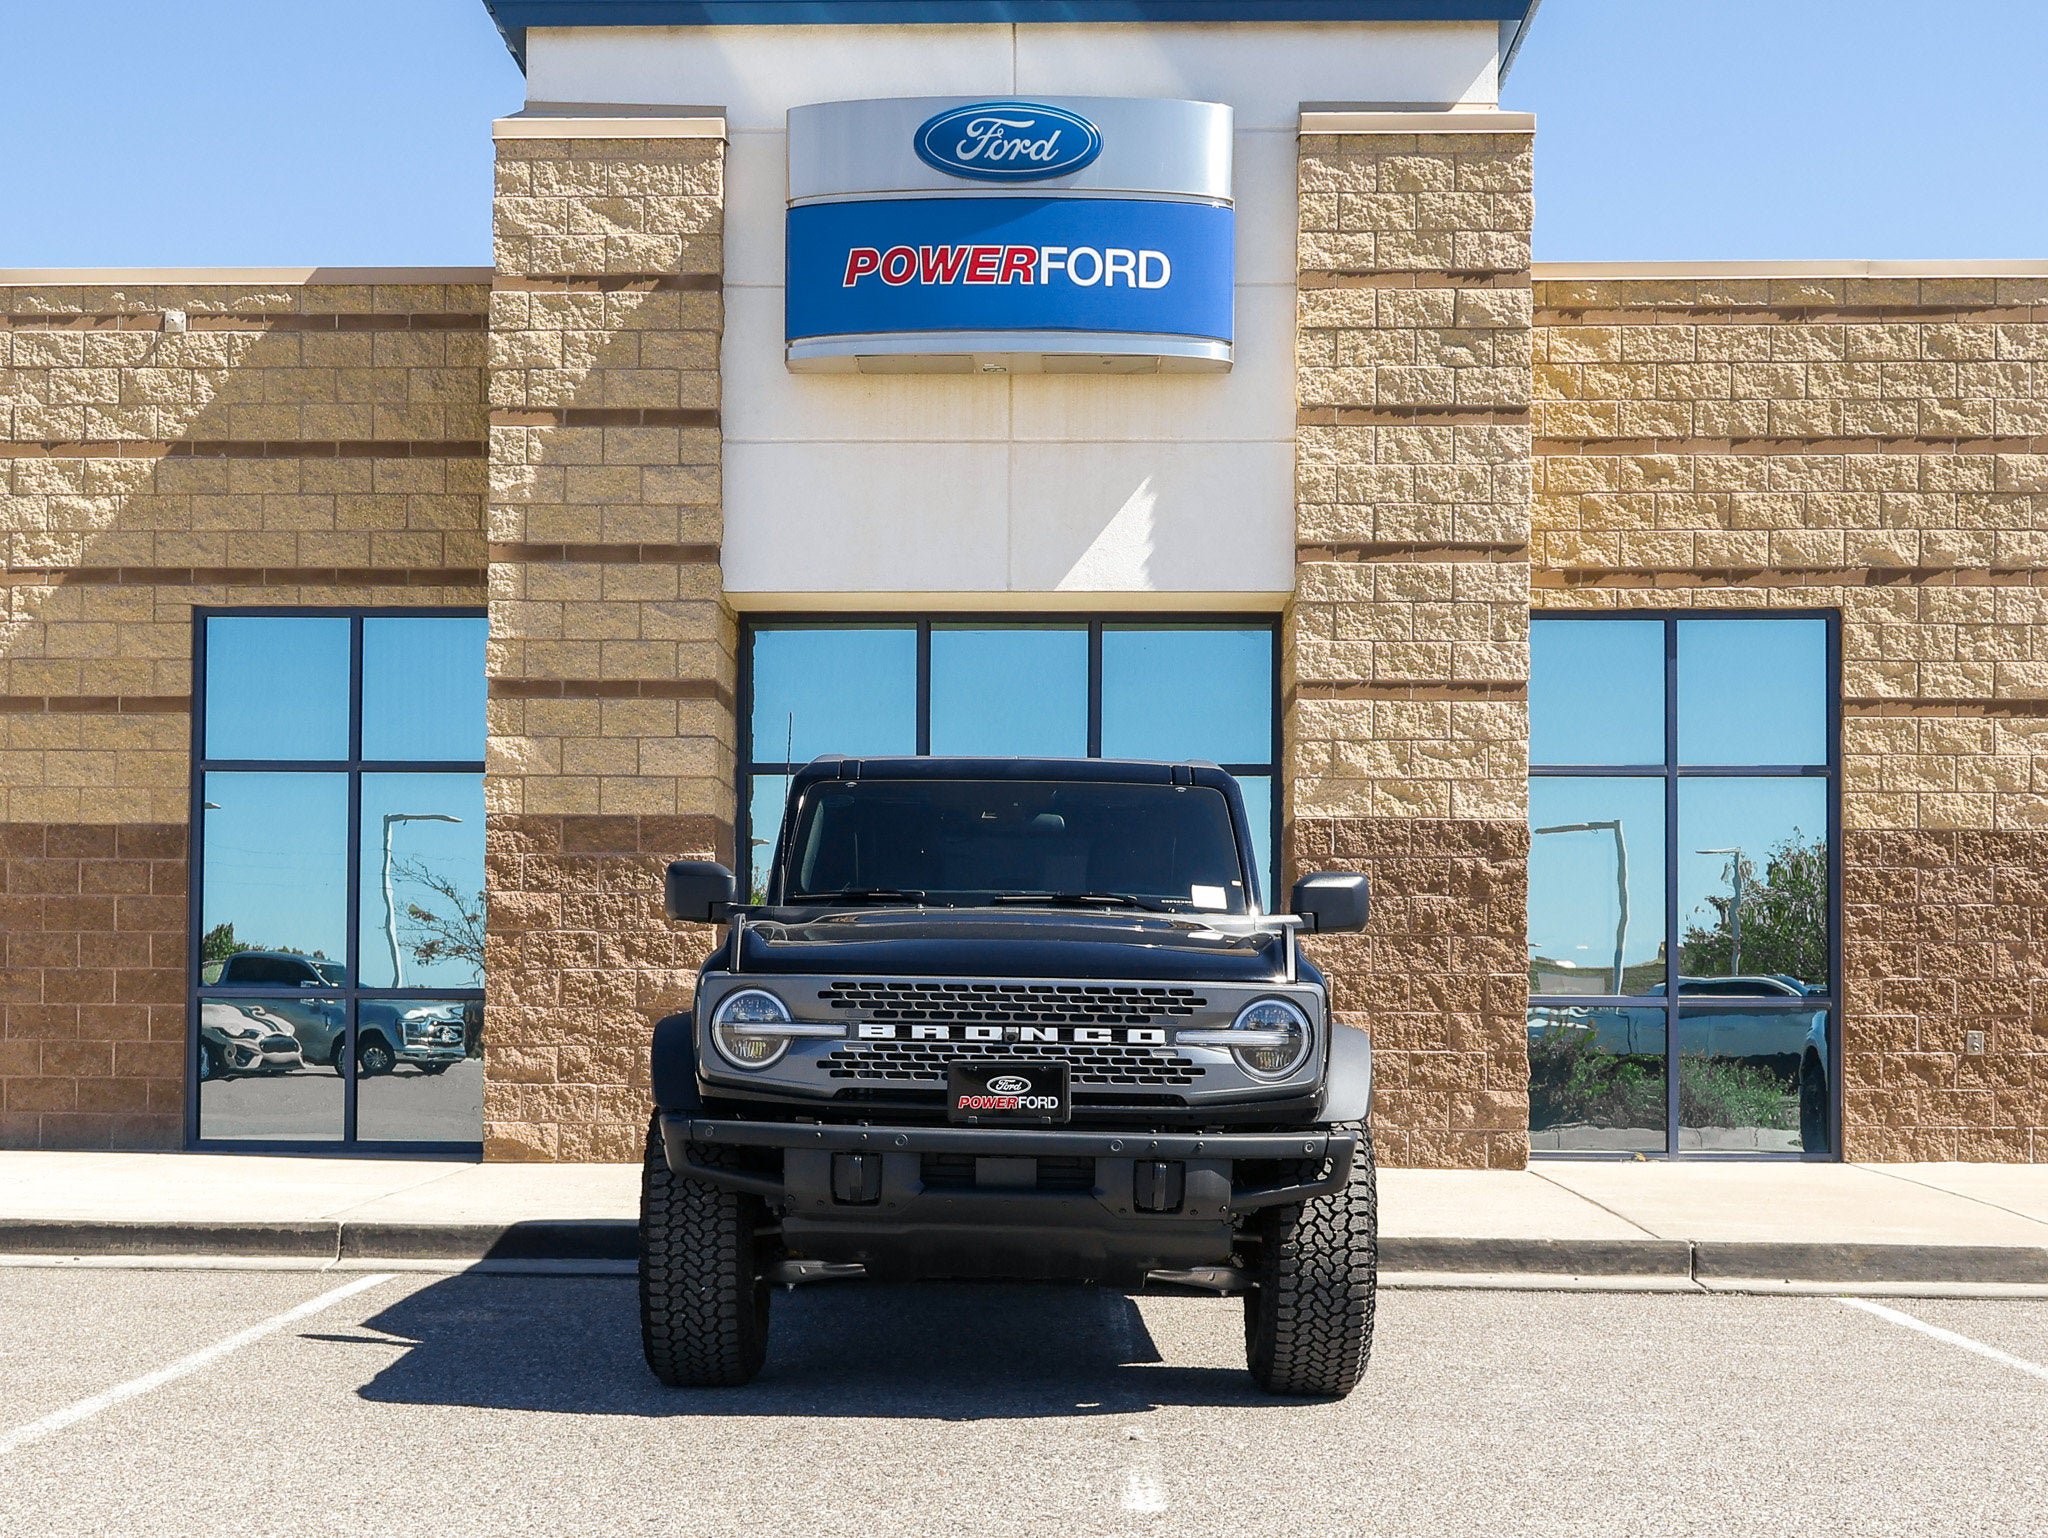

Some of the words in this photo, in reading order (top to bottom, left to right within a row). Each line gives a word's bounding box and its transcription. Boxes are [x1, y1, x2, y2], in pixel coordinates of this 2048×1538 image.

[956, 117, 1062, 161] Ford
[842, 245, 1171, 289] POWERFORD
[858, 1023, 1166, 1047] BRONCO
[995, 1079, 1022, 1092] Ford
[958, 1095, 1059, 1109] POWERFORD
